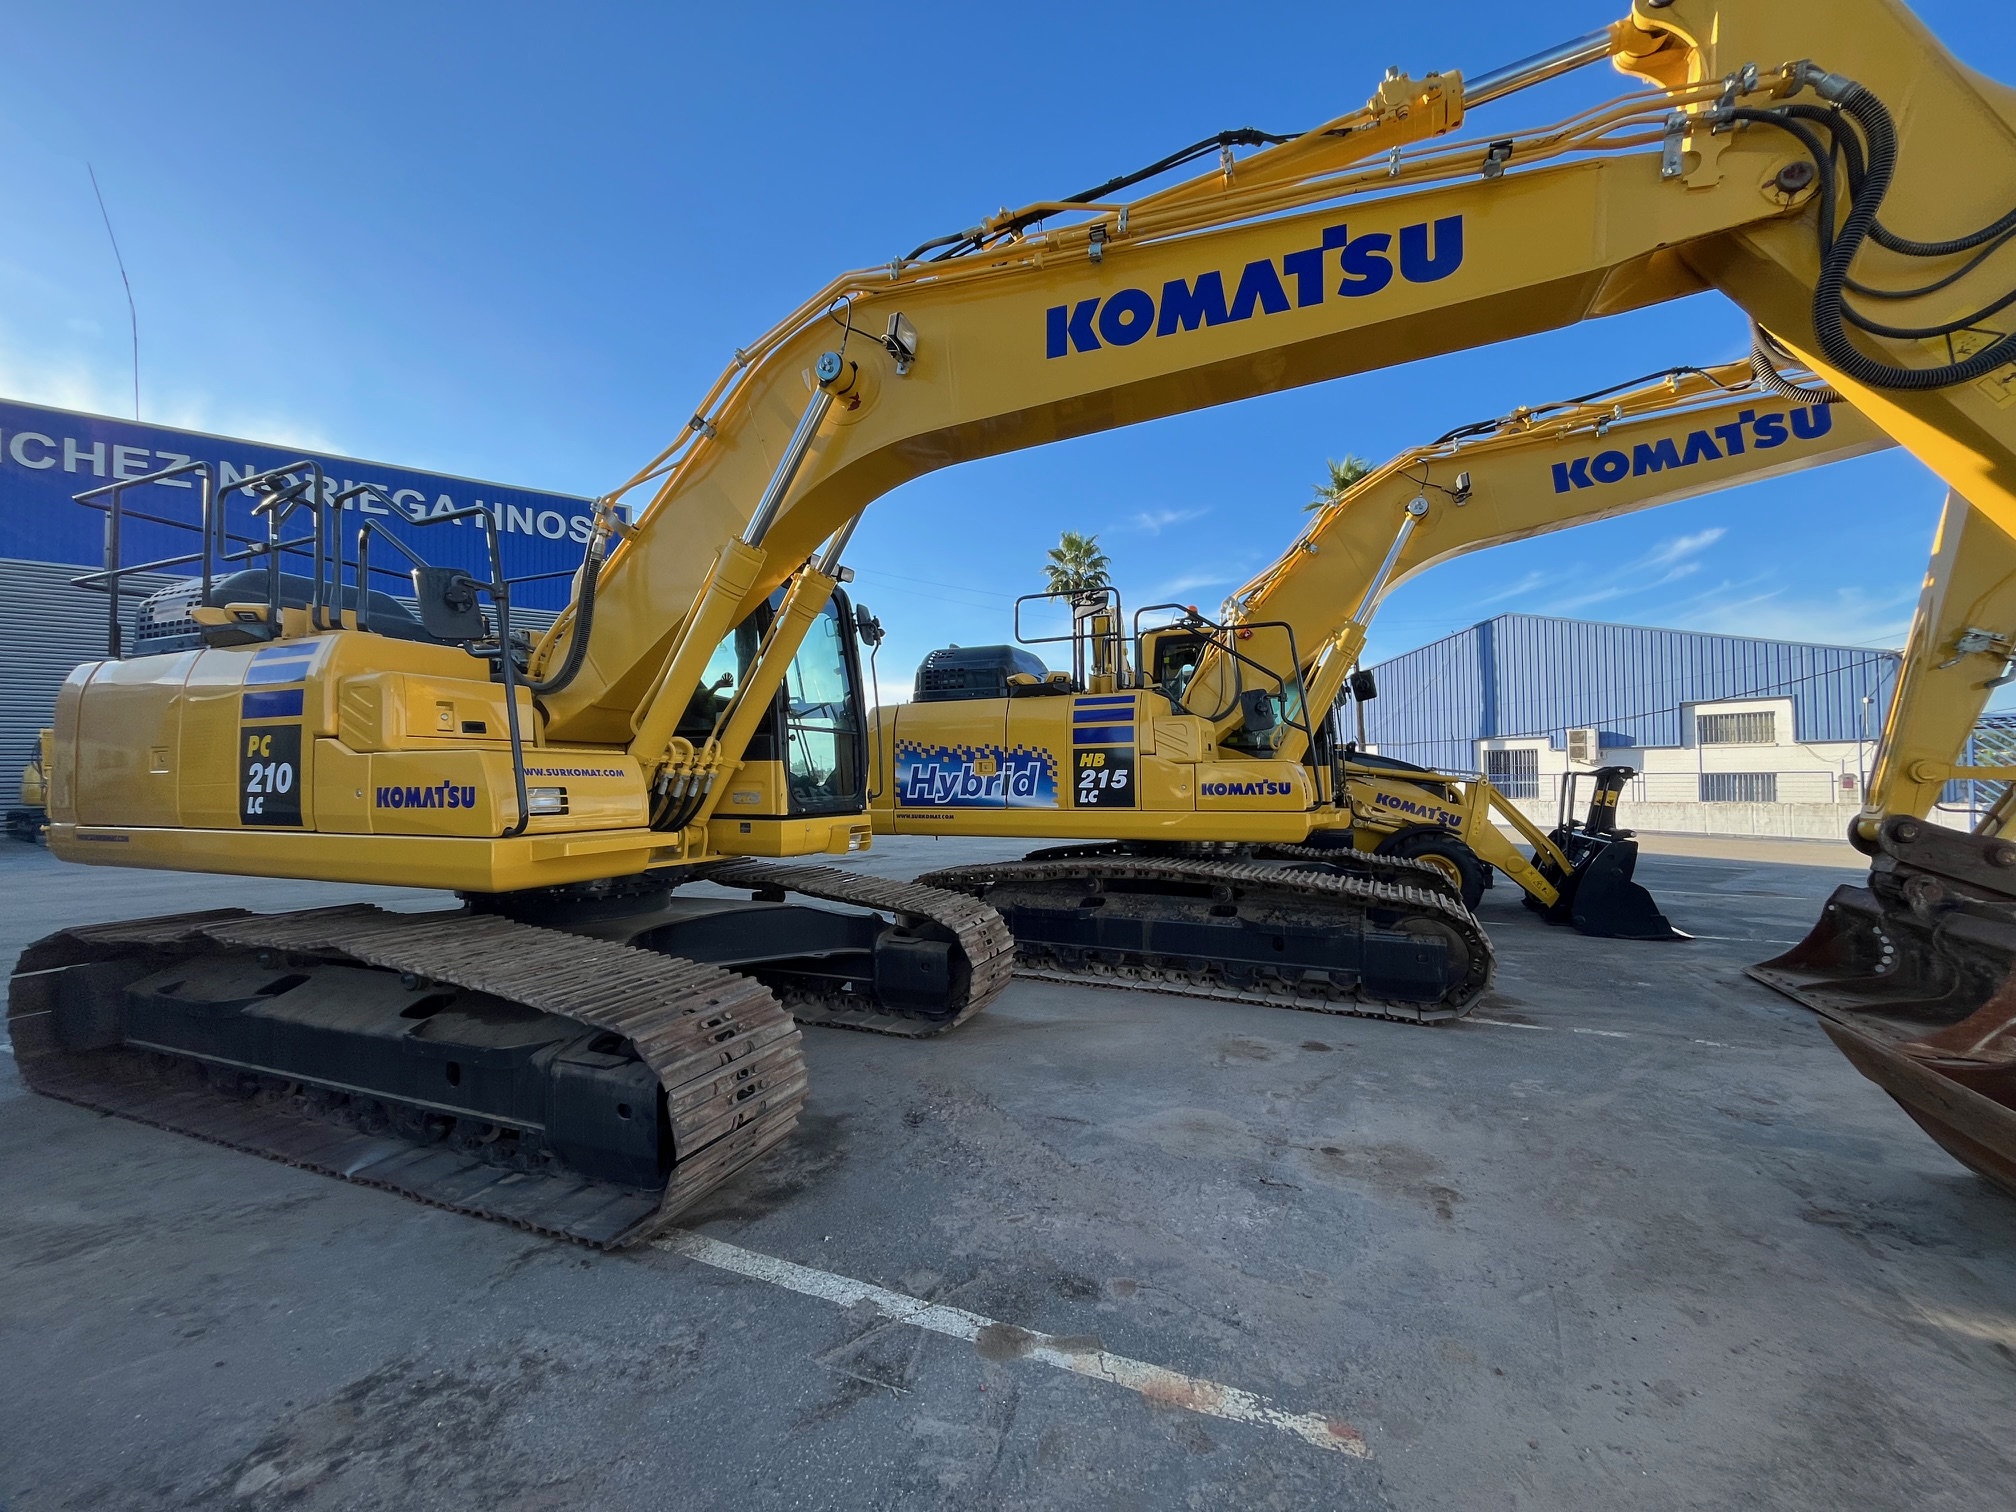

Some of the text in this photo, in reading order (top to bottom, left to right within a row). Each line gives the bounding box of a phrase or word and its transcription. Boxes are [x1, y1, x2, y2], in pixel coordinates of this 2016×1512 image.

[1046, 214, 1464, 359] KOMATSU
[1550, 402, 1833, 493] KOMATSU
[247, 734, 272, 758] PC
[513, 767, 625, 777] WW.SURKOMAT.COM
[1079, 752, 1106, 768] HB
[246, 762, 293, 794] 210
[906, 762, 1041, 804] Hybrid
[1078, 769, 1128, 789] 215
[1201, 779, 1292, 796] KOMATSU
[246, 796, 264, 815] LC
[376, 780, 476, 809] KOMATSU
[1079, 790, 1099, 803] LC
[1375, 792, 1463, 827] KOMATSU
